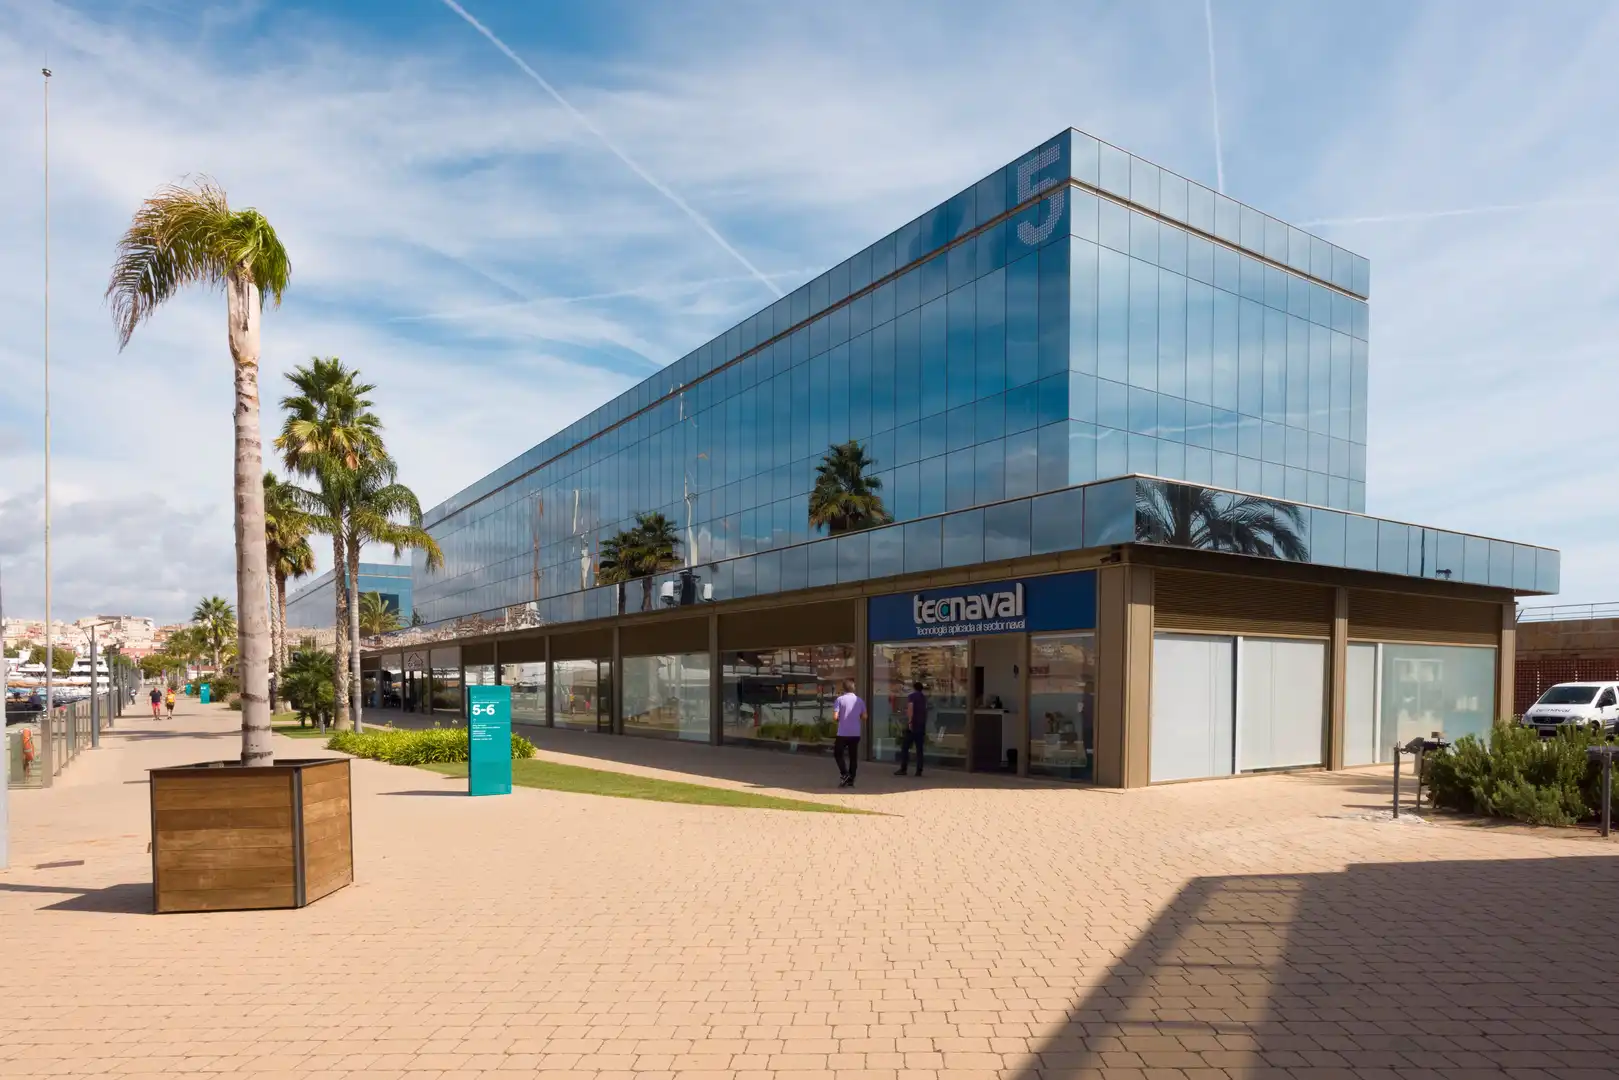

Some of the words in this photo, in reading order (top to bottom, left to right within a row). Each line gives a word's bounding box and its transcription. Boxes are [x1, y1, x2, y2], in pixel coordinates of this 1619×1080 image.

[1017, 143, 1065, 246] 5
[913, 582, 1024, 624] tecnaval
[948, 623, 976, 635] aplicada
[976, 621, 983, 632] al
[983, 620, 1005, 632] sector
[1006, 619, 1025, 630] naval
[472, 704, 495, 715] 5-6
